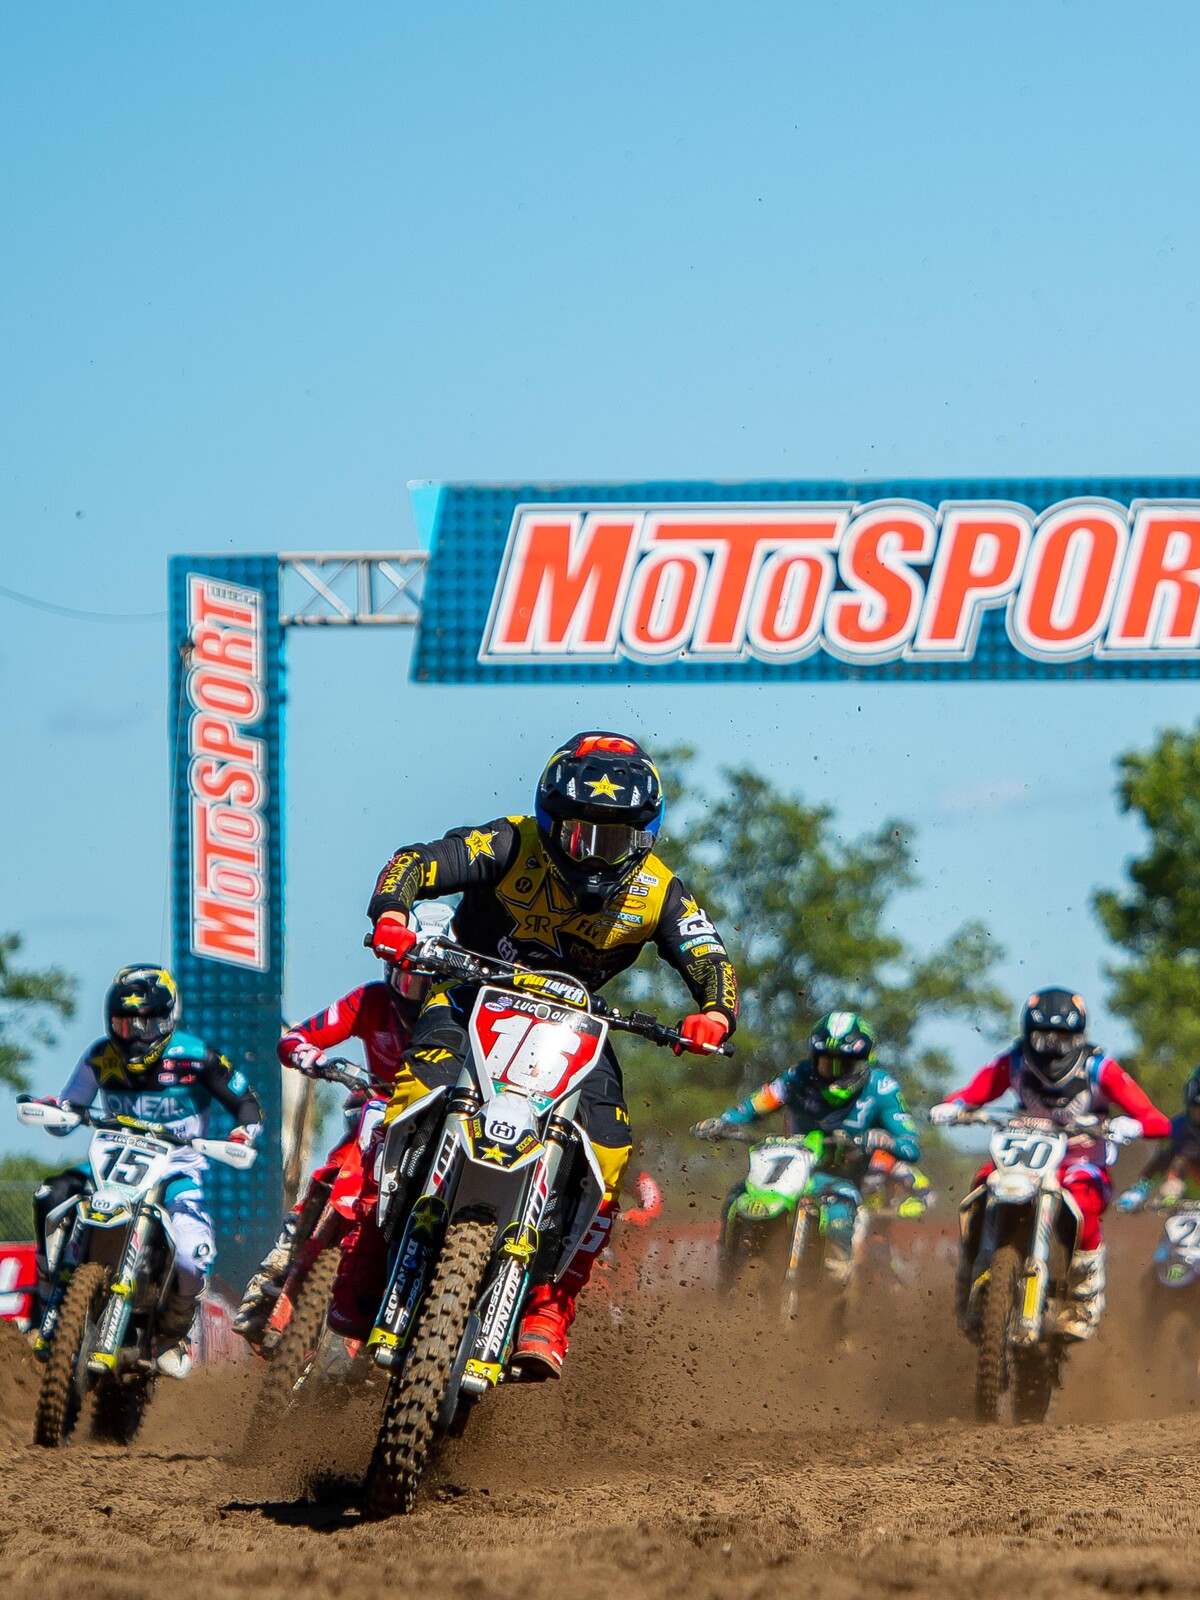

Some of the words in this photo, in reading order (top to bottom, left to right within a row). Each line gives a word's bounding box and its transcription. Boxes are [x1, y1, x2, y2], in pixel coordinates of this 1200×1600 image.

[574, 735, 637, 758] 16
[629, 884, 650, 897] PS
[575, 918, 600, 941] FLY
[517, 972, 585, 1004] PROTAPER
[484, 1014, 582, 1093] 16
[101, 1145, 156, 1187] 15
[1000, 1137, 1053, 1169] 50
[384, 1239, 419, 1325] DUNLOP
[103, 1298, 124, 1351] DUNLOP
[490, 1266, 522, 1358] DUNLOP
